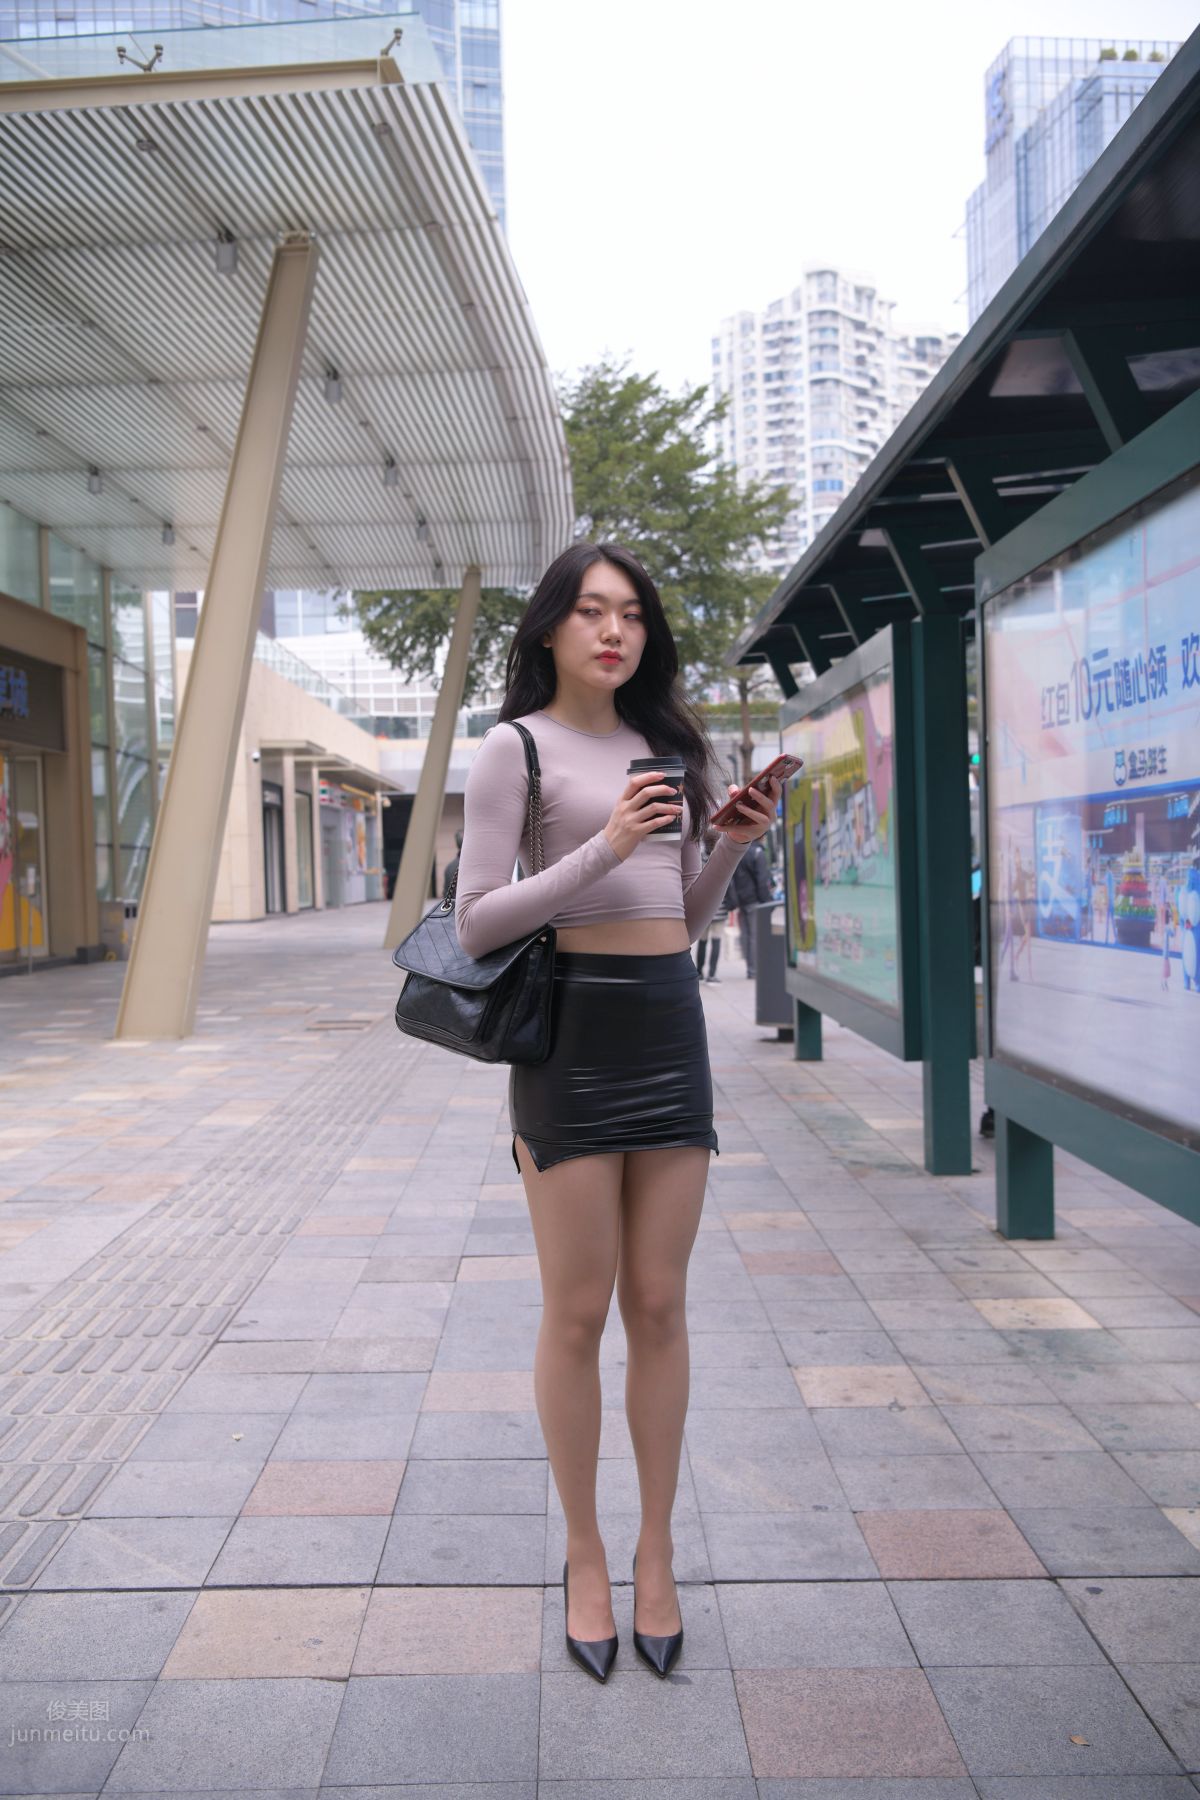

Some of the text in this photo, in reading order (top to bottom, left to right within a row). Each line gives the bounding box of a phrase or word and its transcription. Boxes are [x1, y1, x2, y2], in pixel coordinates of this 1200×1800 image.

[1041, 645, 1168, 730] 红包10元随心领
